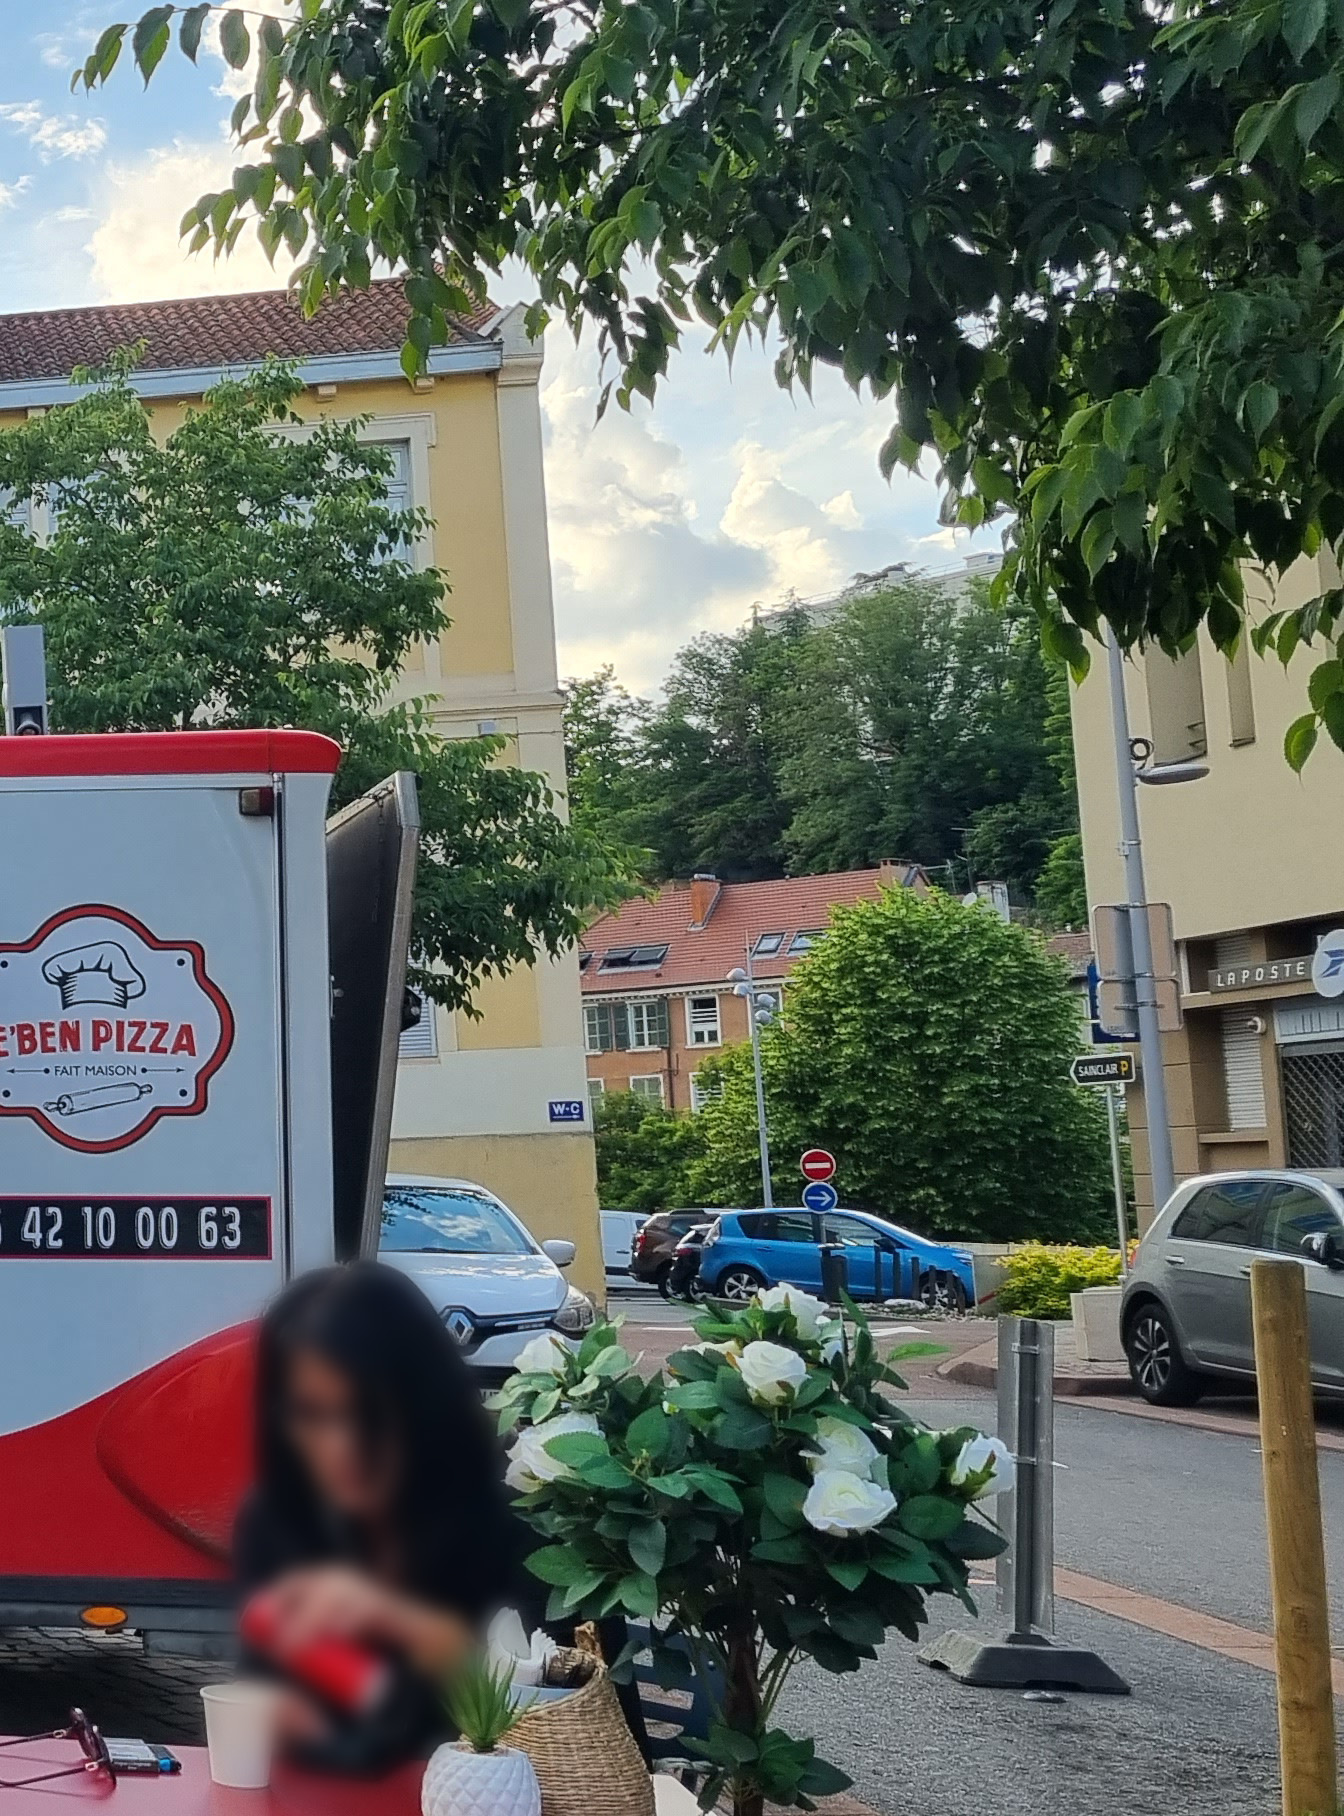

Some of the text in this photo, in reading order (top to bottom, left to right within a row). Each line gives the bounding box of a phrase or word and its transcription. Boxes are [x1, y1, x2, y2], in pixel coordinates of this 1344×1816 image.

[1217, 961, 1305, 986] LA POSTE
[91, 1019, 197, 1057] PIZZA
[54, 1065, 137, 1077] FAIT MAISON
[21, 1206, 63, 1249] 42
[81, 1206, 116, 1249] 10
[135, 1206, 178, 1249] 00
[198, 1206, 241, 1249] 63
